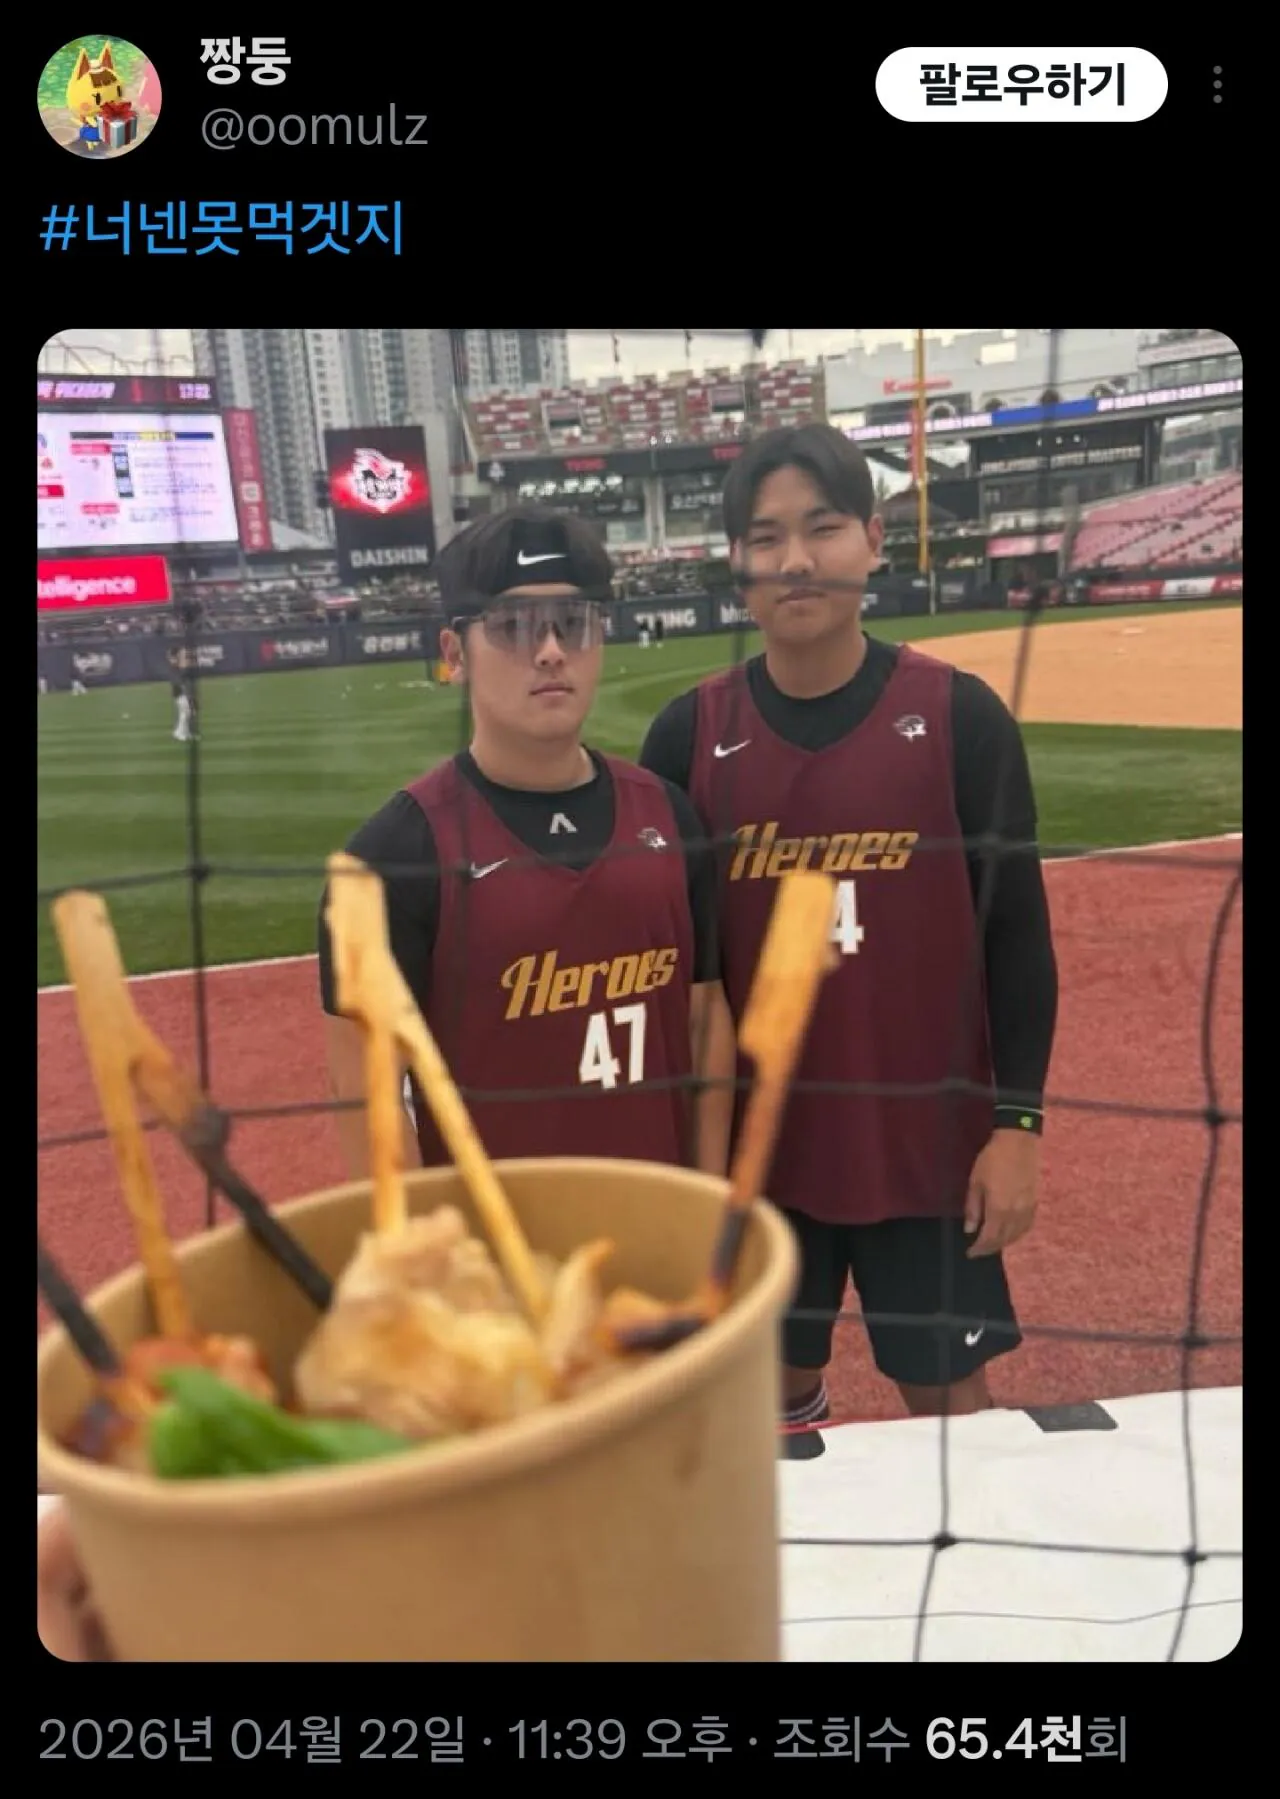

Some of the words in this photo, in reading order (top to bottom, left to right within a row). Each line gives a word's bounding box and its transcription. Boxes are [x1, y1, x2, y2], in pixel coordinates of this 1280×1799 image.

[350, 547, 428, 568] DAISHIN
[729, 822, 919, 881] Heroes
[501, 947, 679, 1020] Heroes
[579, 1002, 646, 1090] 47
